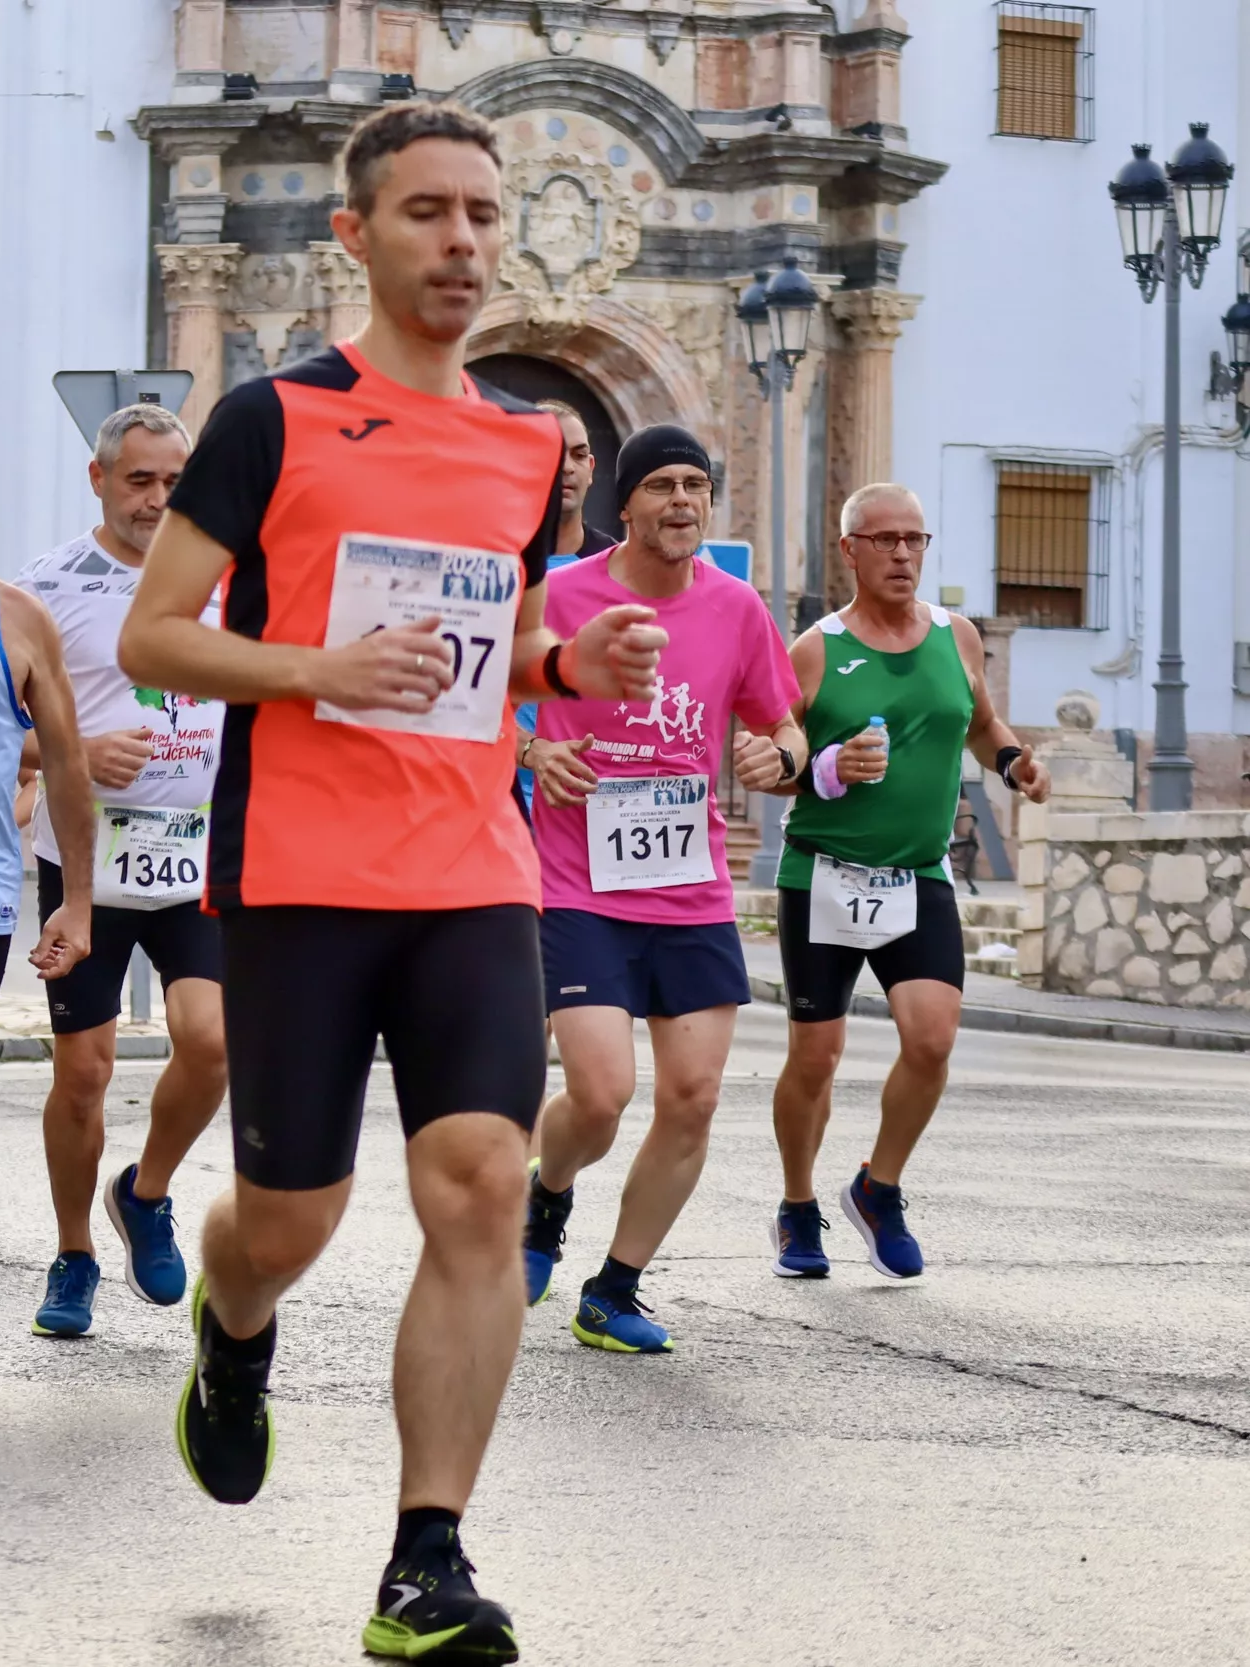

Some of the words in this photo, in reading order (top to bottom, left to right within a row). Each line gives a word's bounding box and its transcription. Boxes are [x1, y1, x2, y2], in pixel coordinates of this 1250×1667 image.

[150, 744, 206, 762] LUCENA
[591, 739, 637, 756] SUMANDO
[637, 744, 656, 758] KM
[653, 779, 682, 792] 2024
[607, 824, 695, 861] 1317
[115, 851, 199, 887] 1340
[846, 897, 884, 925] 17
